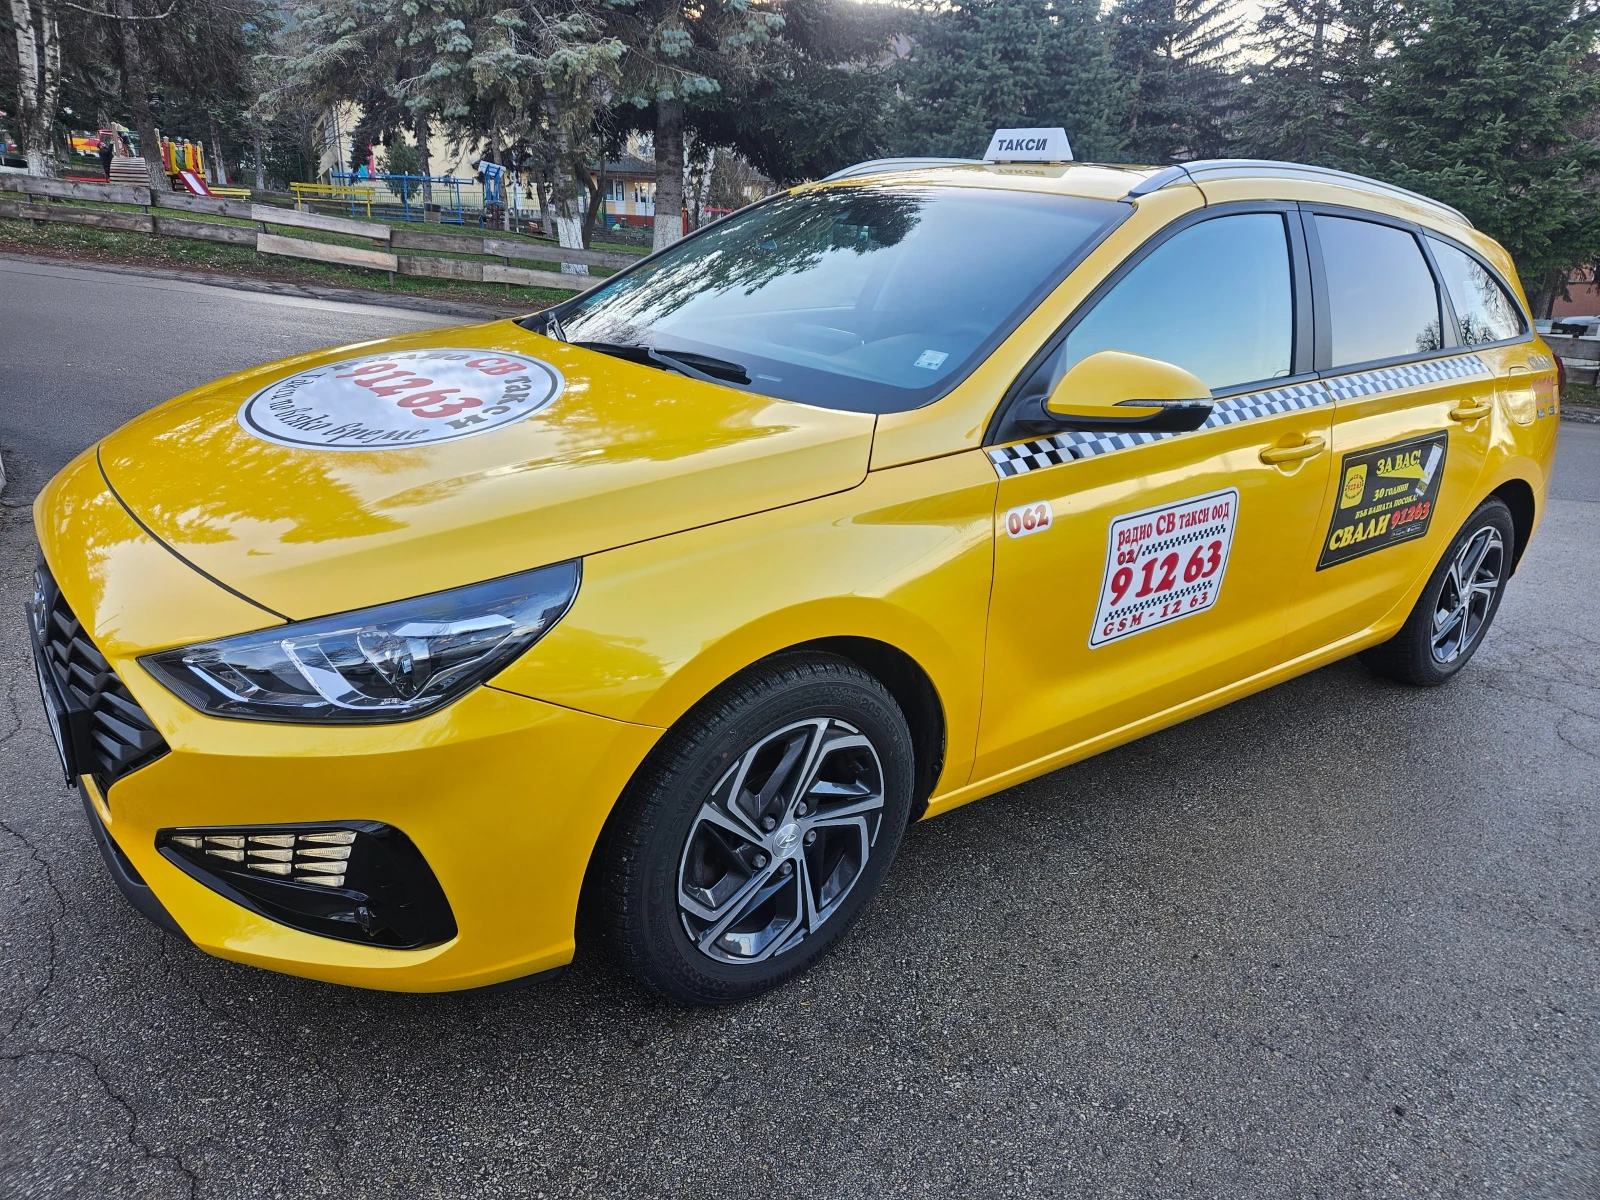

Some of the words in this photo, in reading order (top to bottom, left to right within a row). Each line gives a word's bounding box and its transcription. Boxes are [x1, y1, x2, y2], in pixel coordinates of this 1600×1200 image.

[998, 138, 1048, 151] ТАКСИ
[335, 363, 484, 419] 91263
[1376, 456, 1393, 476] ЗА
[1394, 450, 1422, 470] ВАС!
[1372, 488, 1385, 502] 30
[1008, 504, 1049, 535] 062
[1156, 512, 1176, 536] СВ
[1329, 513, 1391, 551] СВАЛИ
[1391, 501, 1431, 530] 91263
[1117, 544, 1143, 566] 02/
[1103, 612, 1144, 636] GSM
[1160, 600, 1182, 618] 12
[1190, 592, 1208, 608] 63
